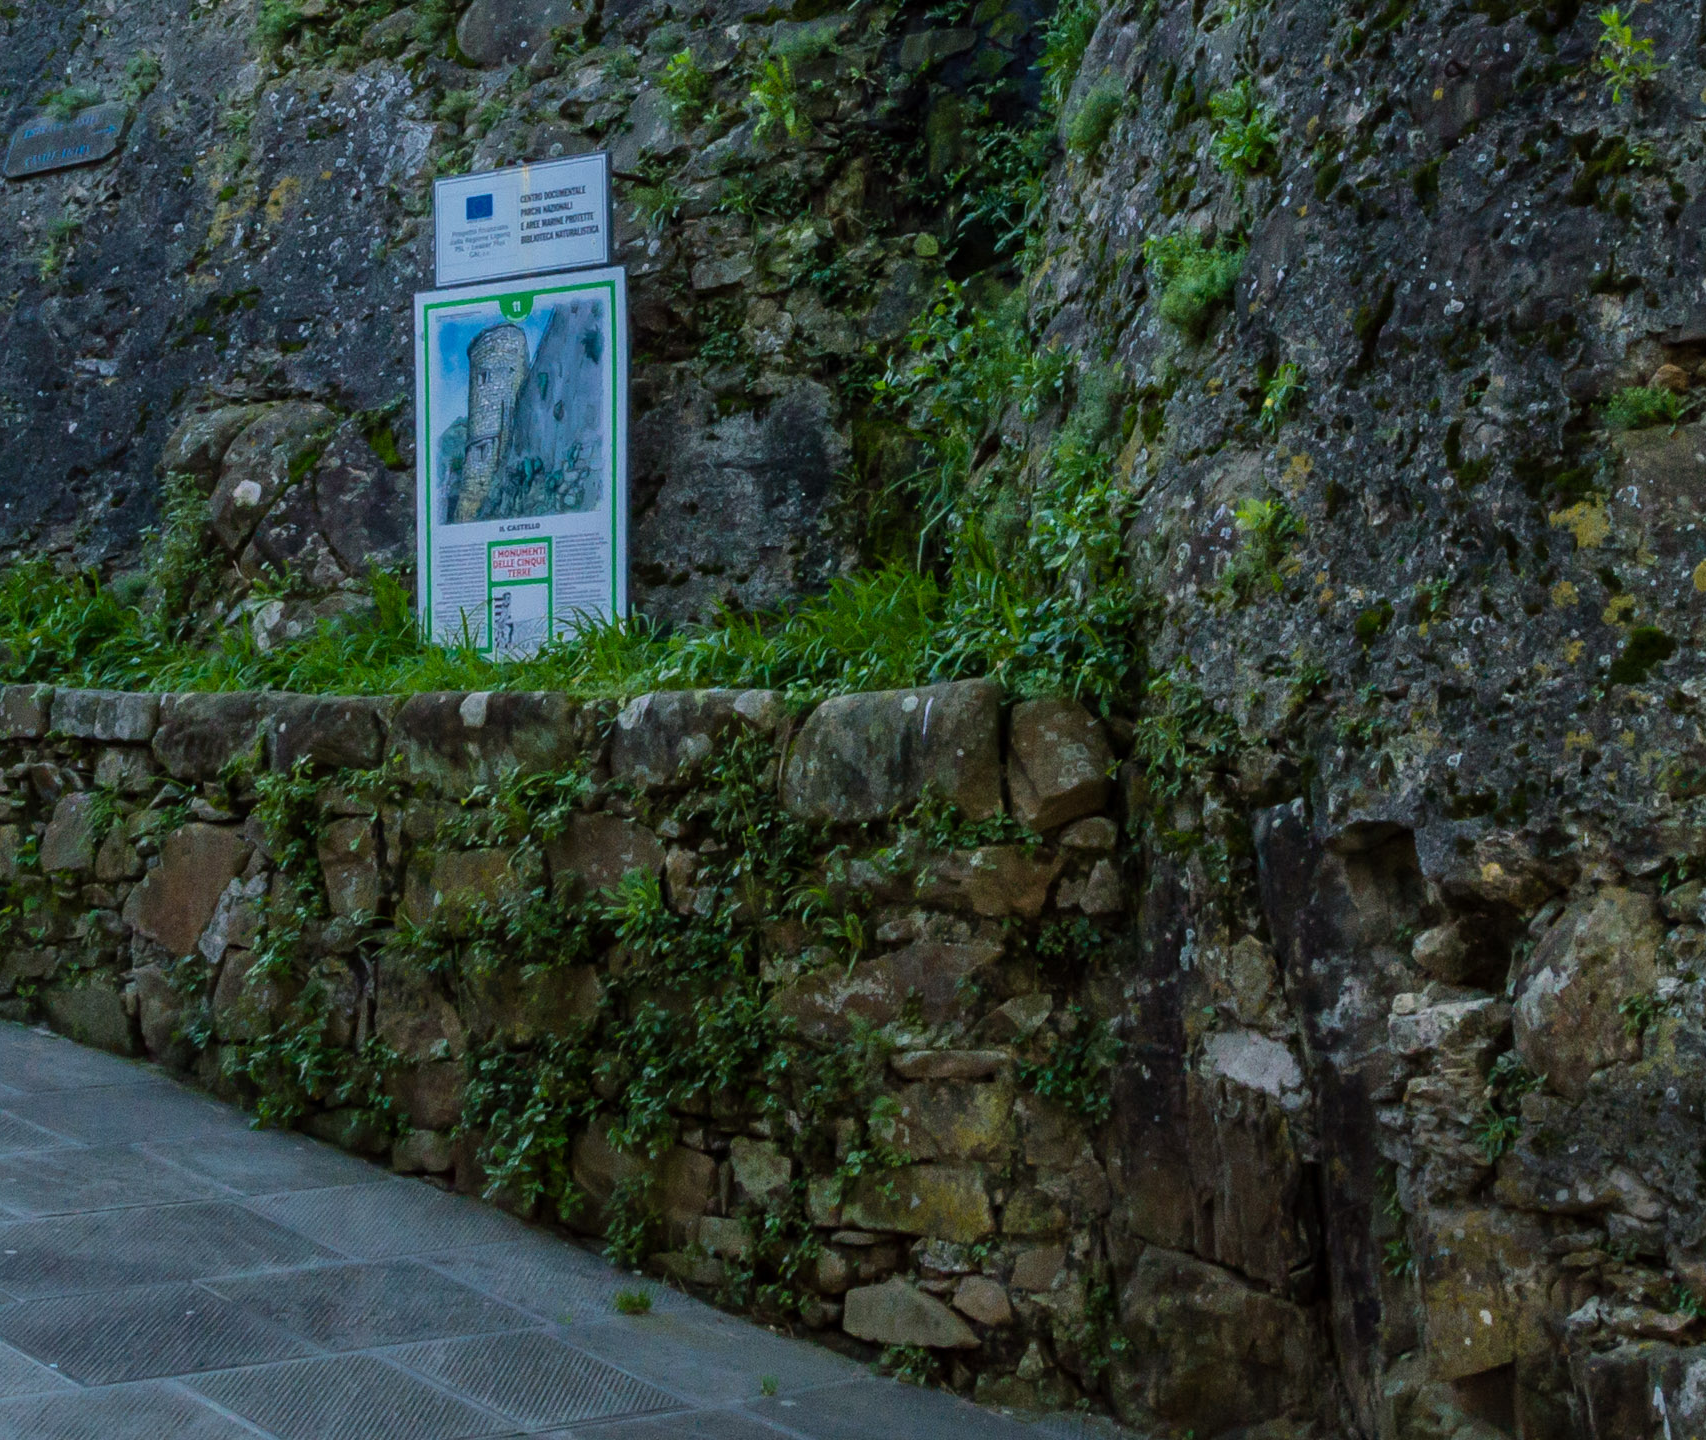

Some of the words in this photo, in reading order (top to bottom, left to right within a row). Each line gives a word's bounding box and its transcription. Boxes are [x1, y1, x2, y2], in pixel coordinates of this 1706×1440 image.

[520, 192, 542, 203] CENTRO
[544, 185, 586, 200] DOCUMENTALE
[520, 207, 542, 217] PARCHI
[543, 201, 573, 213] NAZIONALI
[526, 219, 540, 229] AREE
[542, 216, 564, 228] MARINE
[565, 212, 595, 223] PROTETTE
[520, 232, 553, 244] BIBLIOTECA
[555, 225, 599, 239] NATURALISTICA
[512, 301, 521, 312] 11
[507, 522, 541, 531] CASTELLO
[498, 546, 546, 558] MONUMENTI
[493, 559, 514, 569] DELLE
[517, 557, 546, 567] CINQUE
[508, 568, 531, 577] TERRE
